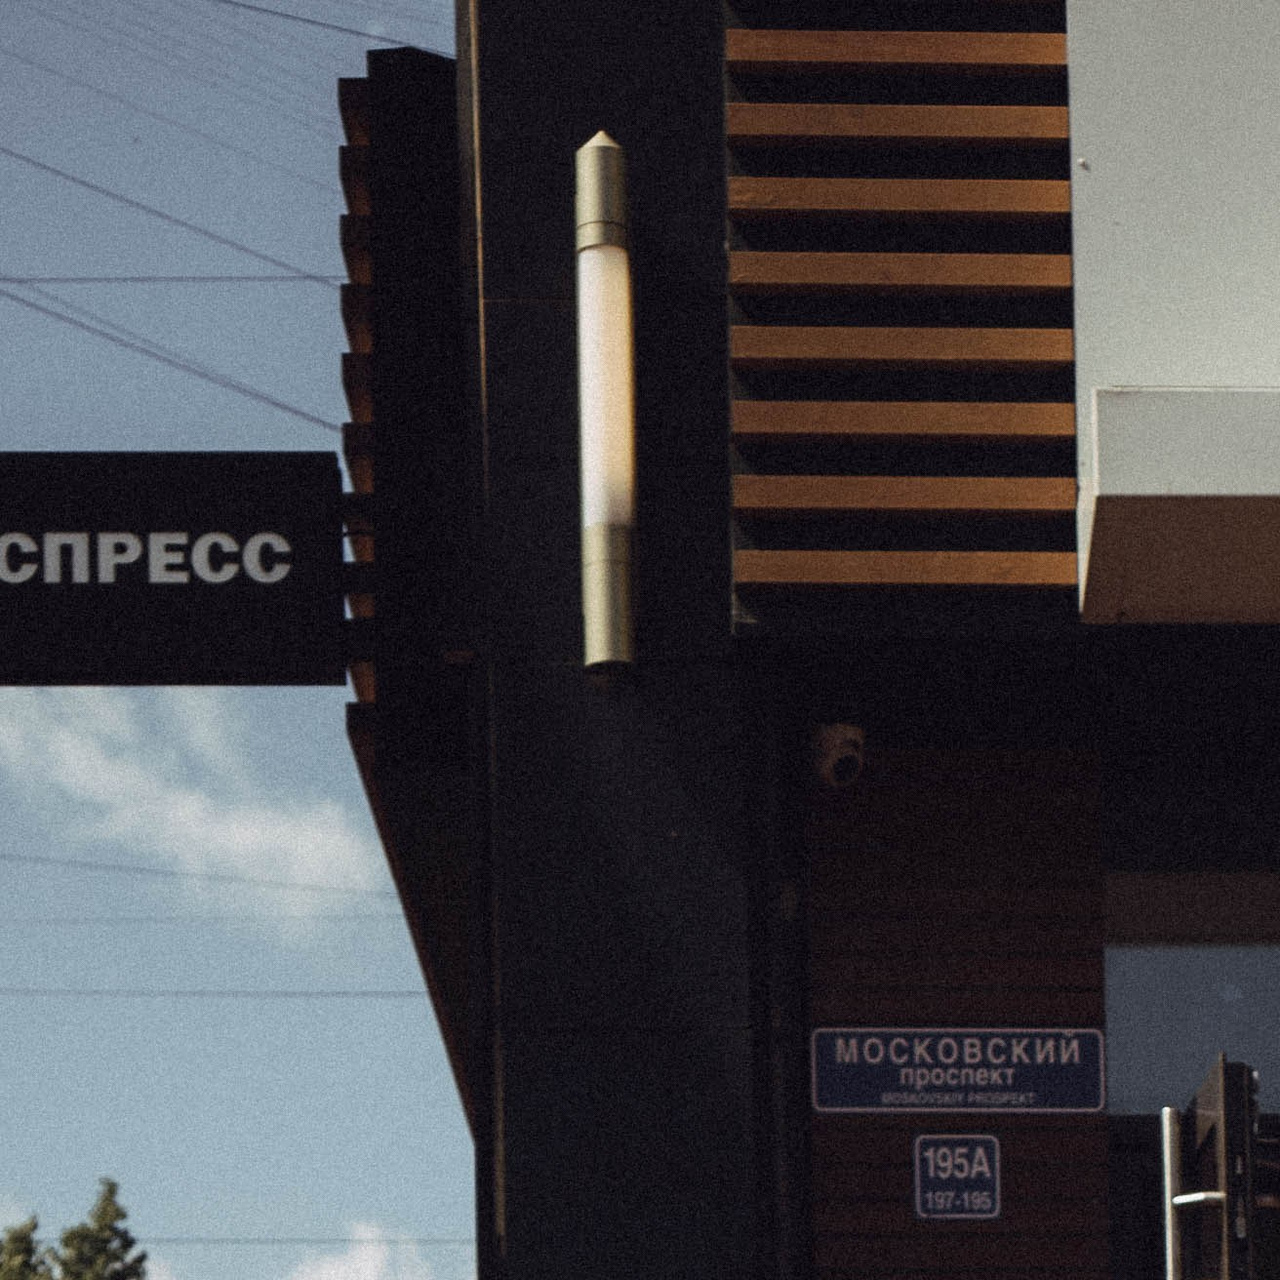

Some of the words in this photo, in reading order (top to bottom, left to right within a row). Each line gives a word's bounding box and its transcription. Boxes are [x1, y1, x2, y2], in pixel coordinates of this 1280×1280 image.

[834, 1031, 1081, 1065] МОСКОВСКИЙ
[899, 1066, 1016, 1089] проспект
[924, 1146, 991, 1179] 195А
